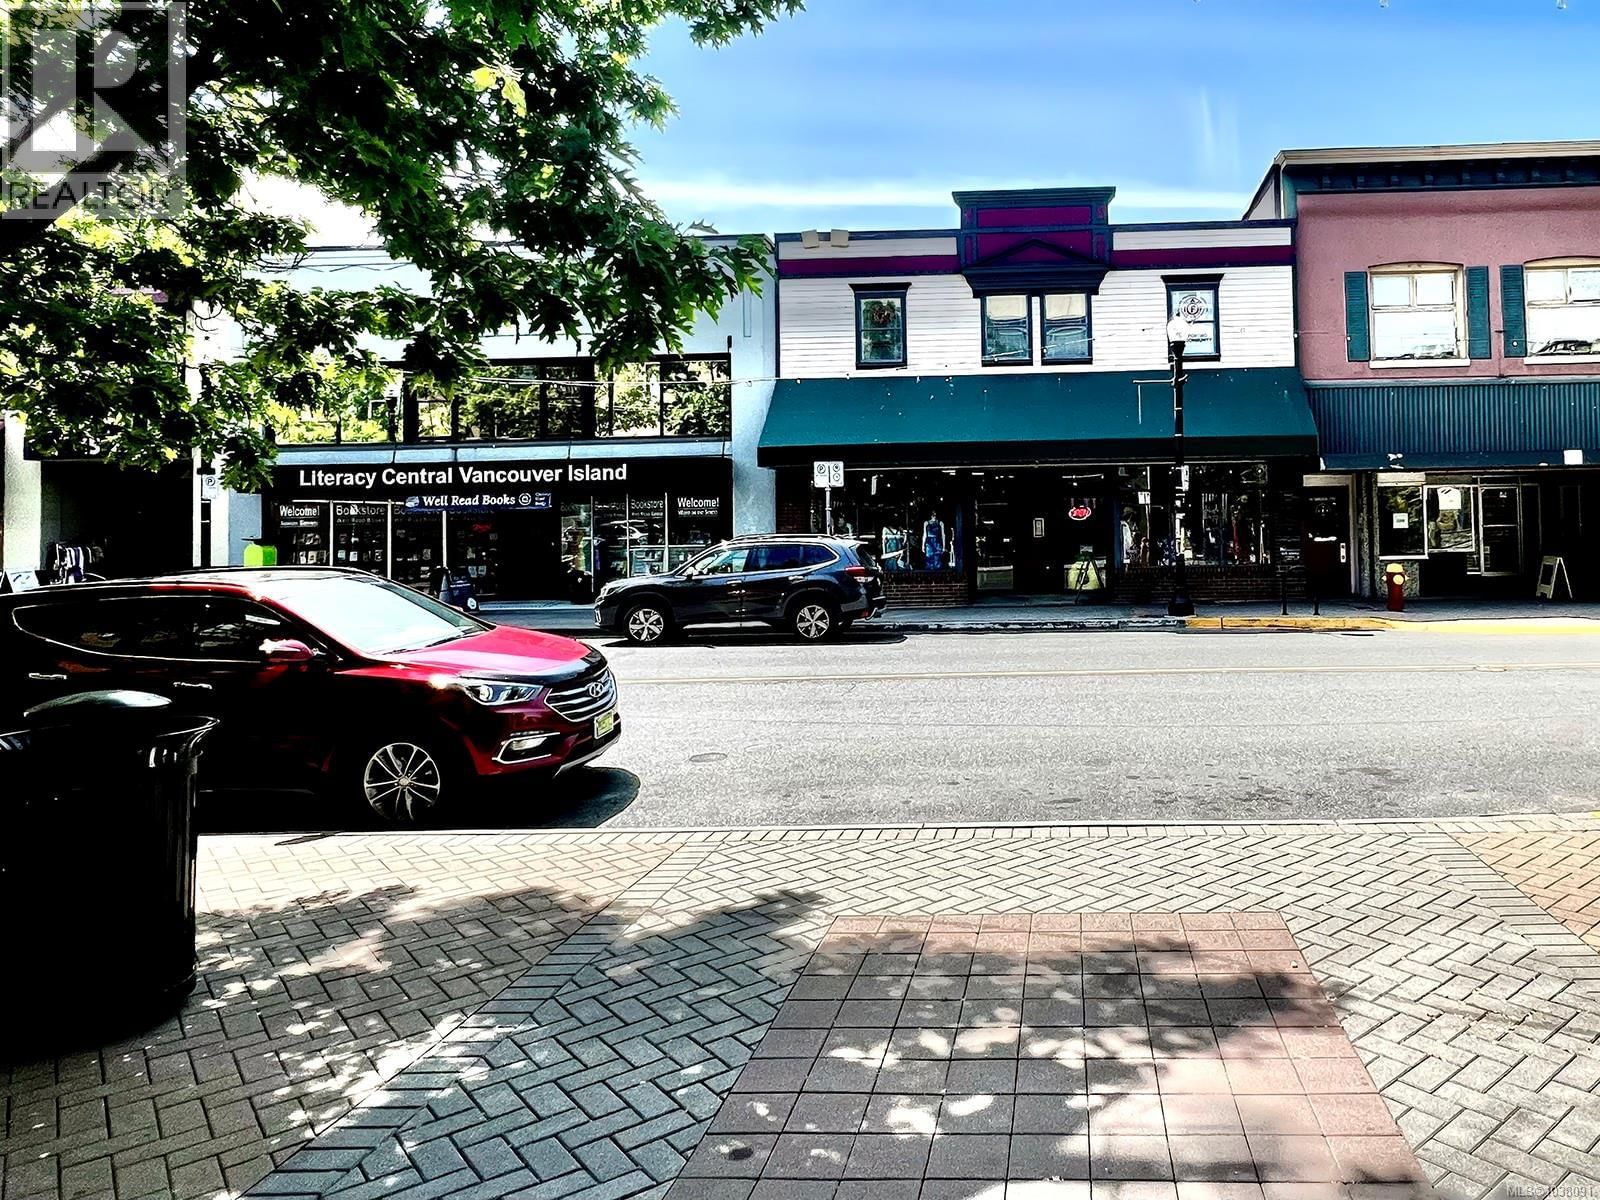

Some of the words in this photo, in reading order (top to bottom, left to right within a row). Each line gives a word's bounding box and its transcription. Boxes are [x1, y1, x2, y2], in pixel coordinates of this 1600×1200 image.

[299, 468, 377, 489] Literacy
[381, 467, 453, 485] Central
[458, 466, 563, 484] Vancouver
[568, 463, 627, 482] Island
[421, 495, 449, 507] Well
[450, 494, 480, 506] Read
[481, 493, 516, 506] Books
[677, 497, 720, 508] Welcome!
[279, 504, 320, 517] Welcome!
